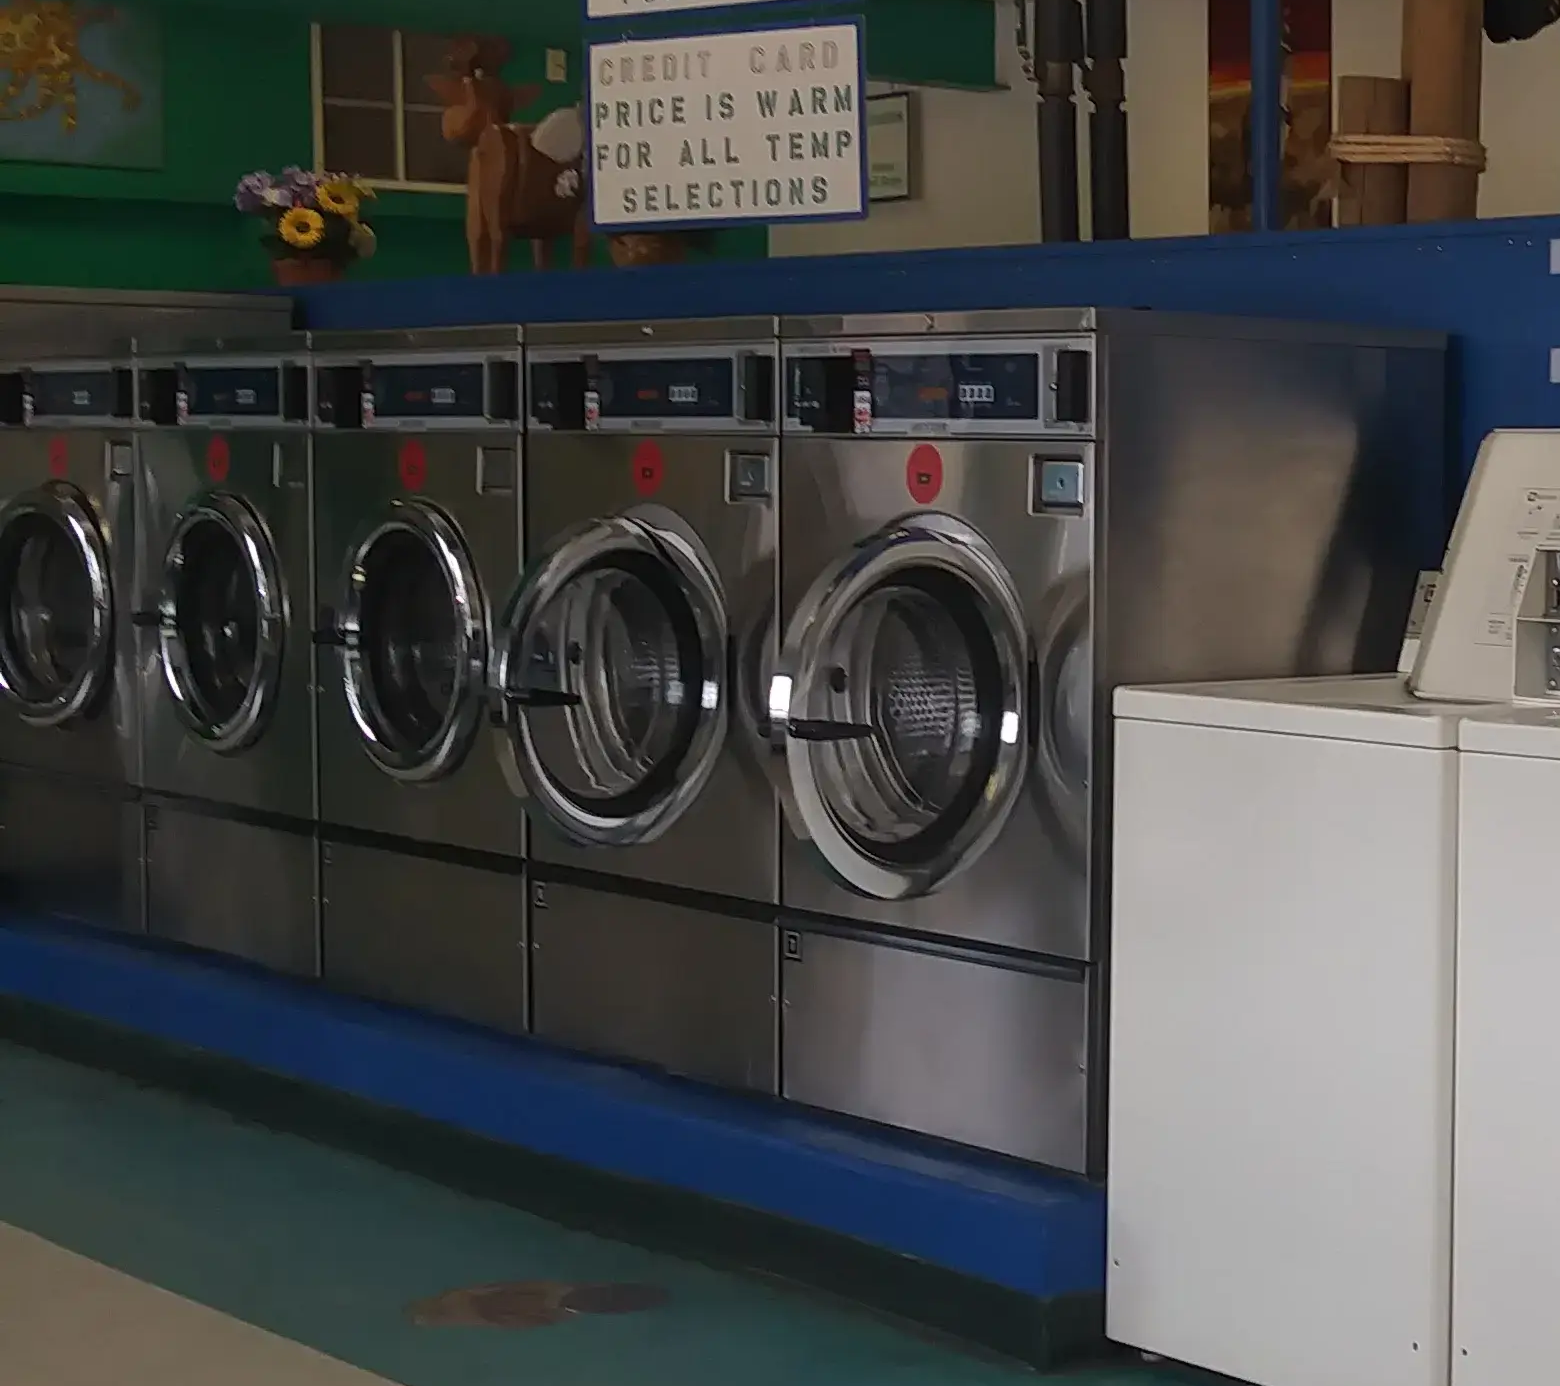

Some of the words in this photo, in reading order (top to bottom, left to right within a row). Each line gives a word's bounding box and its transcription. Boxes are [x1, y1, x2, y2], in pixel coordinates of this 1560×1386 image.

[599, 50, 712, 87] CREDIT
[749, 40, 838, 75] CARD
[595, 96, 686, 130] PRICE
[705, 92, 736, 121] IS
[756, 84, 853, 118] WARM
[596, 141, 652, 171] FOR
[678, 137, 741, 167] ALL
[766, 130, 853, 162] TEMP
[622, 176, 829, 214] SELECTIONS
